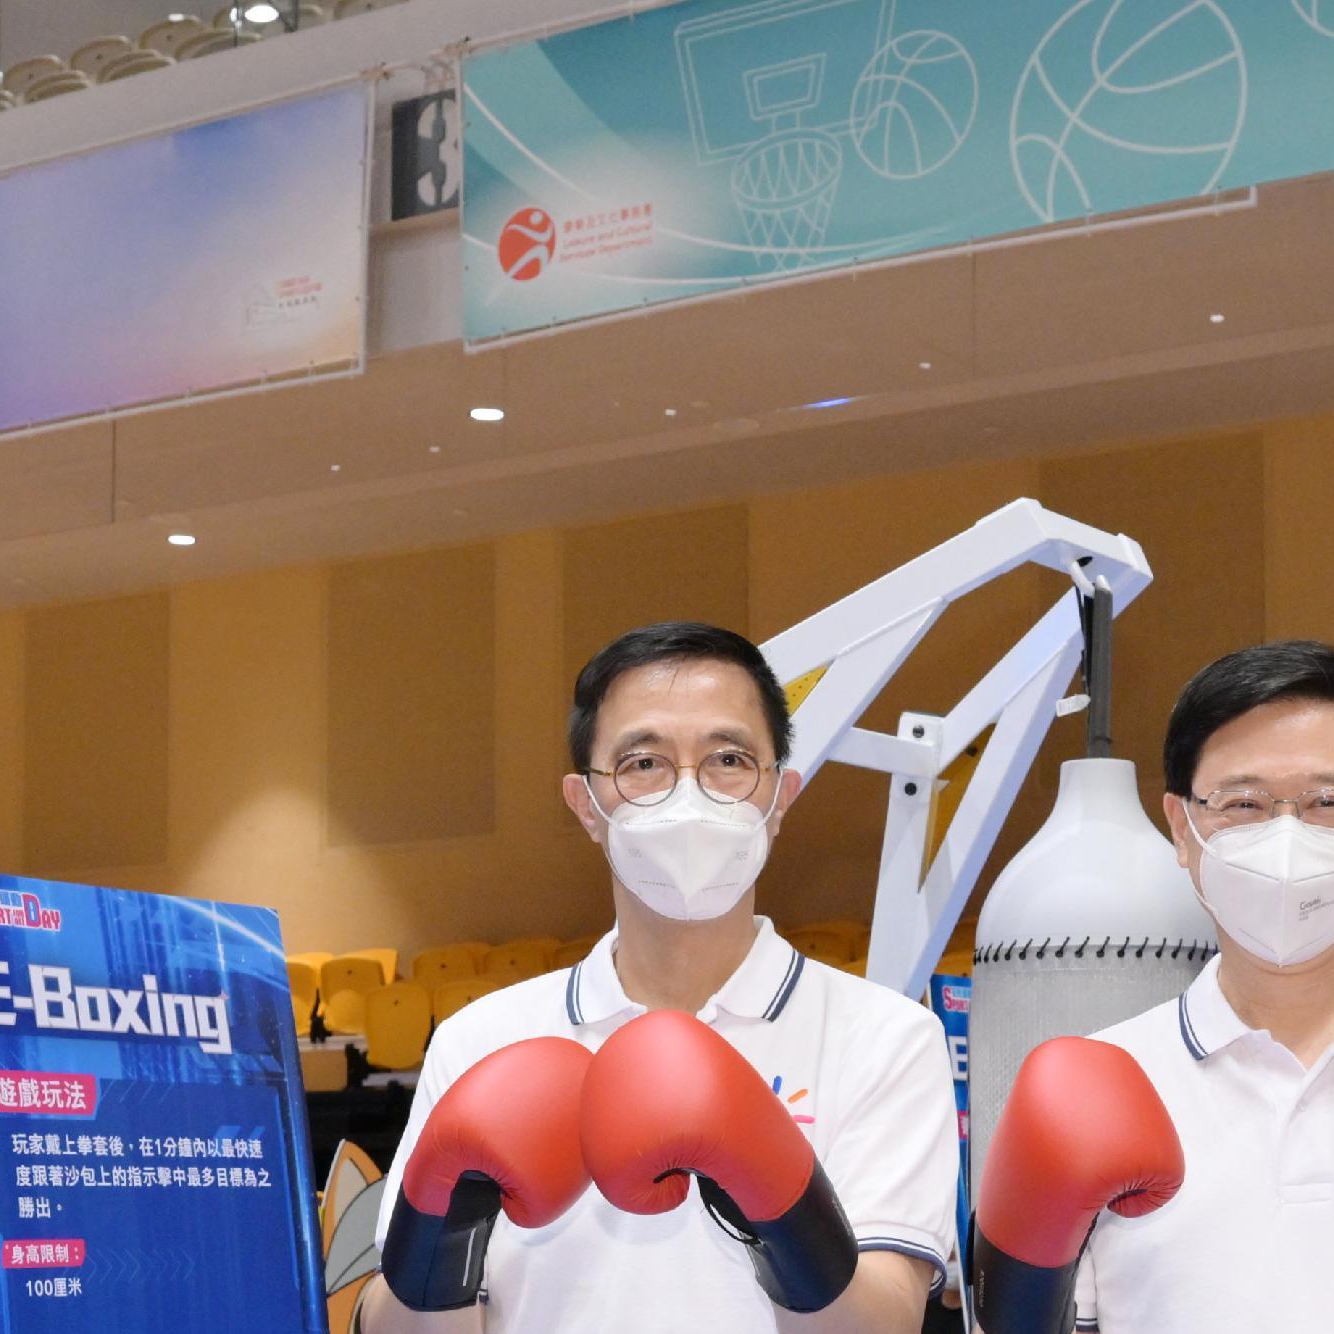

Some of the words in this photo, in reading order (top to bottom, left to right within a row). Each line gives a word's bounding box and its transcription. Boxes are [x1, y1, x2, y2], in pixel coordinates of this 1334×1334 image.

[15, 1164, 272, 1188] 度跟著沙包上的指示擊中最多目標為之
[25, 1277, 83, 1298] 100厘米
